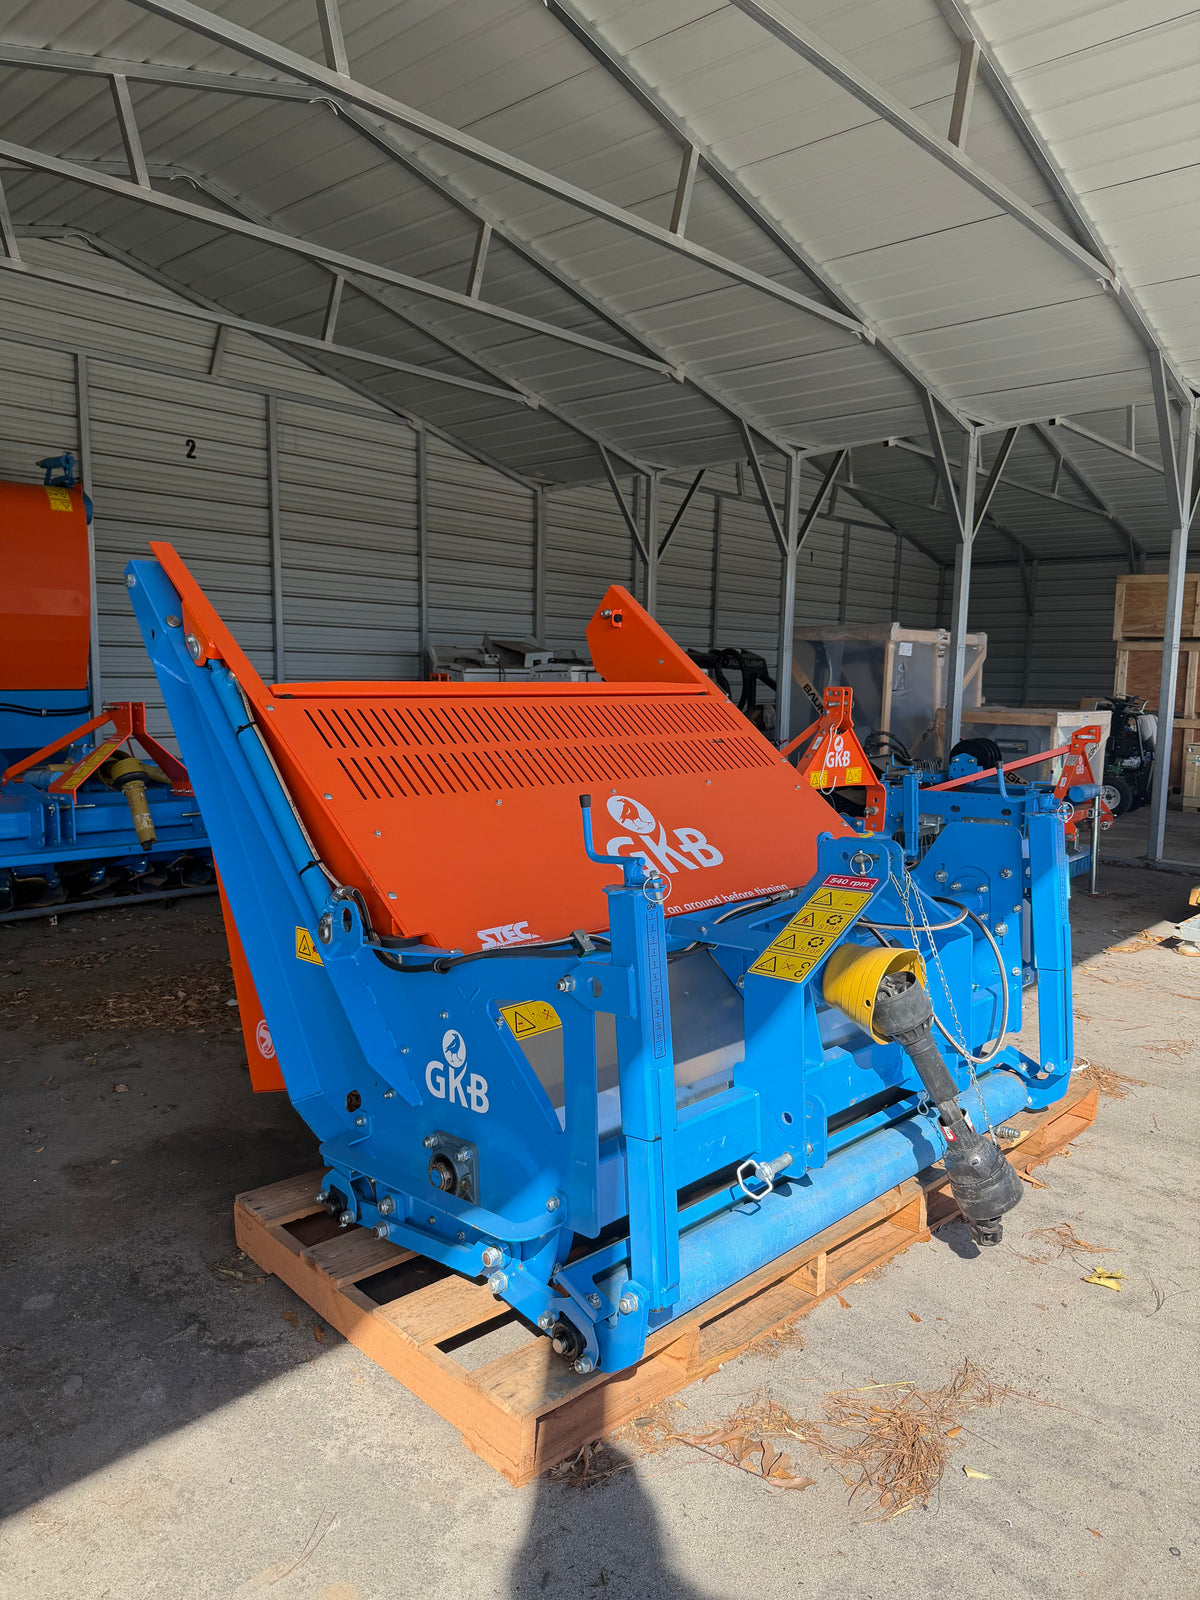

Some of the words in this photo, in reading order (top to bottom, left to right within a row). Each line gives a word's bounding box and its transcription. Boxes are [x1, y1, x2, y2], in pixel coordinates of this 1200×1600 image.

[186, 439, 197, 459] 2
[826, 750, 850, 768] GKB
[606, 820, 724, 878] GKB
[850, 880, 870, 888] rpm
[667, 905, 683, 914] on
[425, 1061, 489, 1114] GKB
